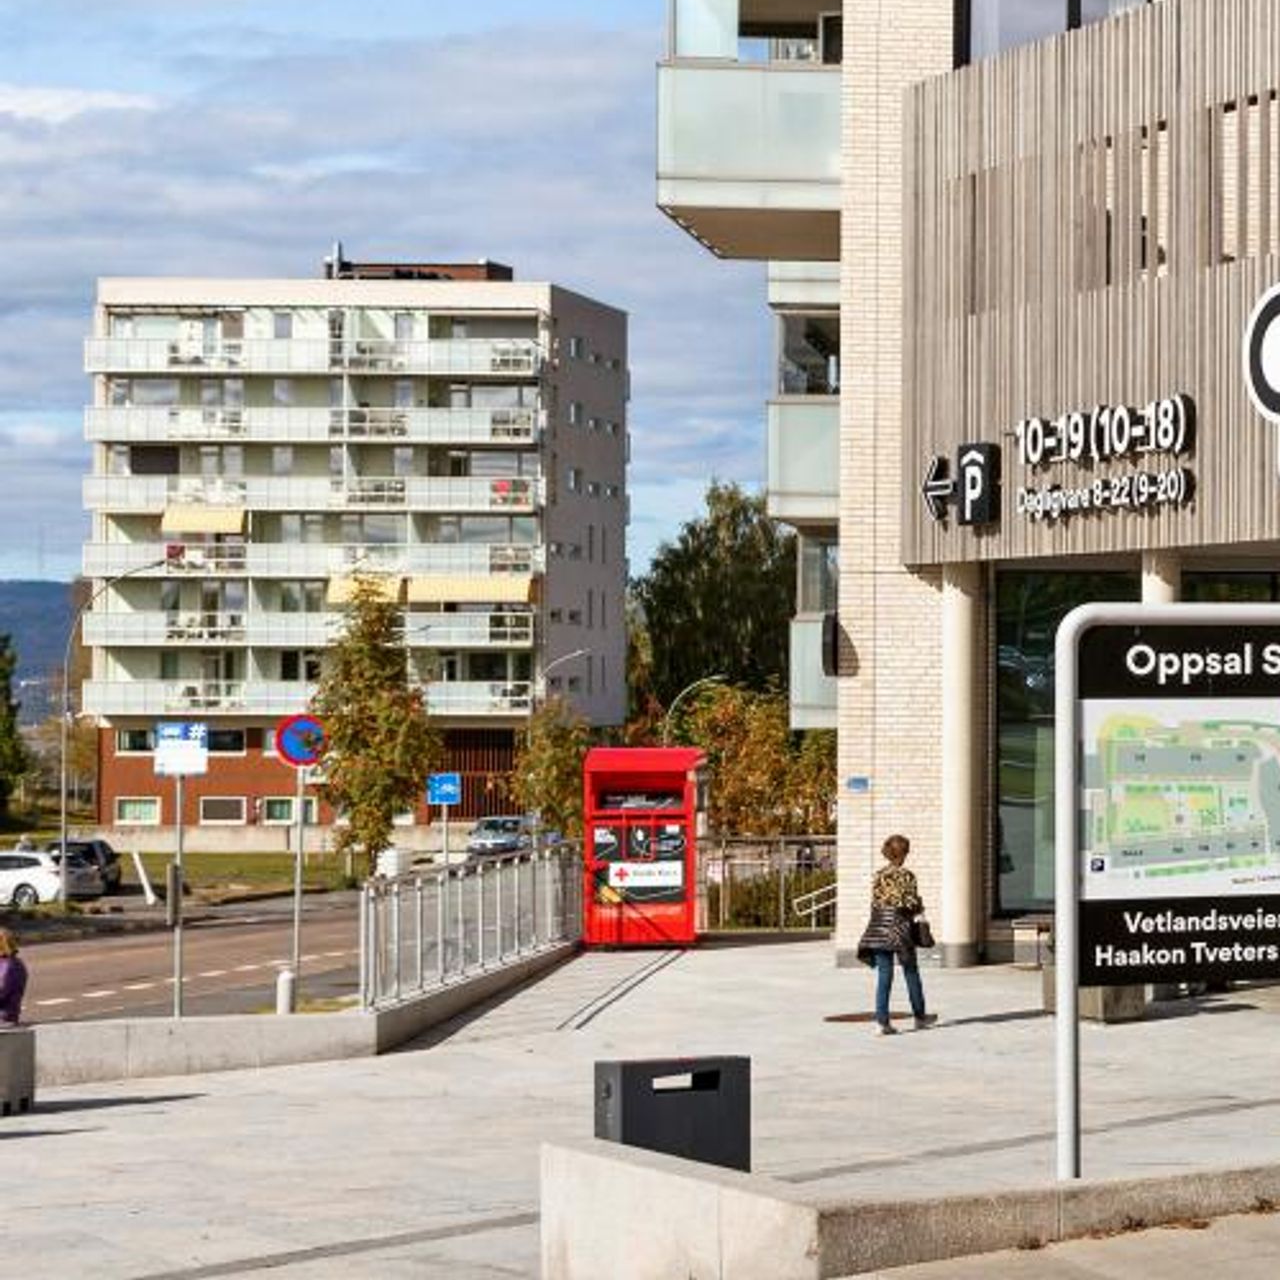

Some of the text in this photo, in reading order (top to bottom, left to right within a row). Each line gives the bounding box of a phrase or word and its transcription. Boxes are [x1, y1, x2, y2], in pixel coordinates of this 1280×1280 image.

[1014, 395, 1186, 464] 10-19 (10-18)
[964, 466, 982, 520] P
[1093, 477, 1129, 508] 8-22
[1132, 468, 1185, 504] (9-20)
[1125, 643, 1252, 685] Oppsal
[1095, 946, 1185, 966] Haakon
[1191, 943, 1278, 964] Tveters
